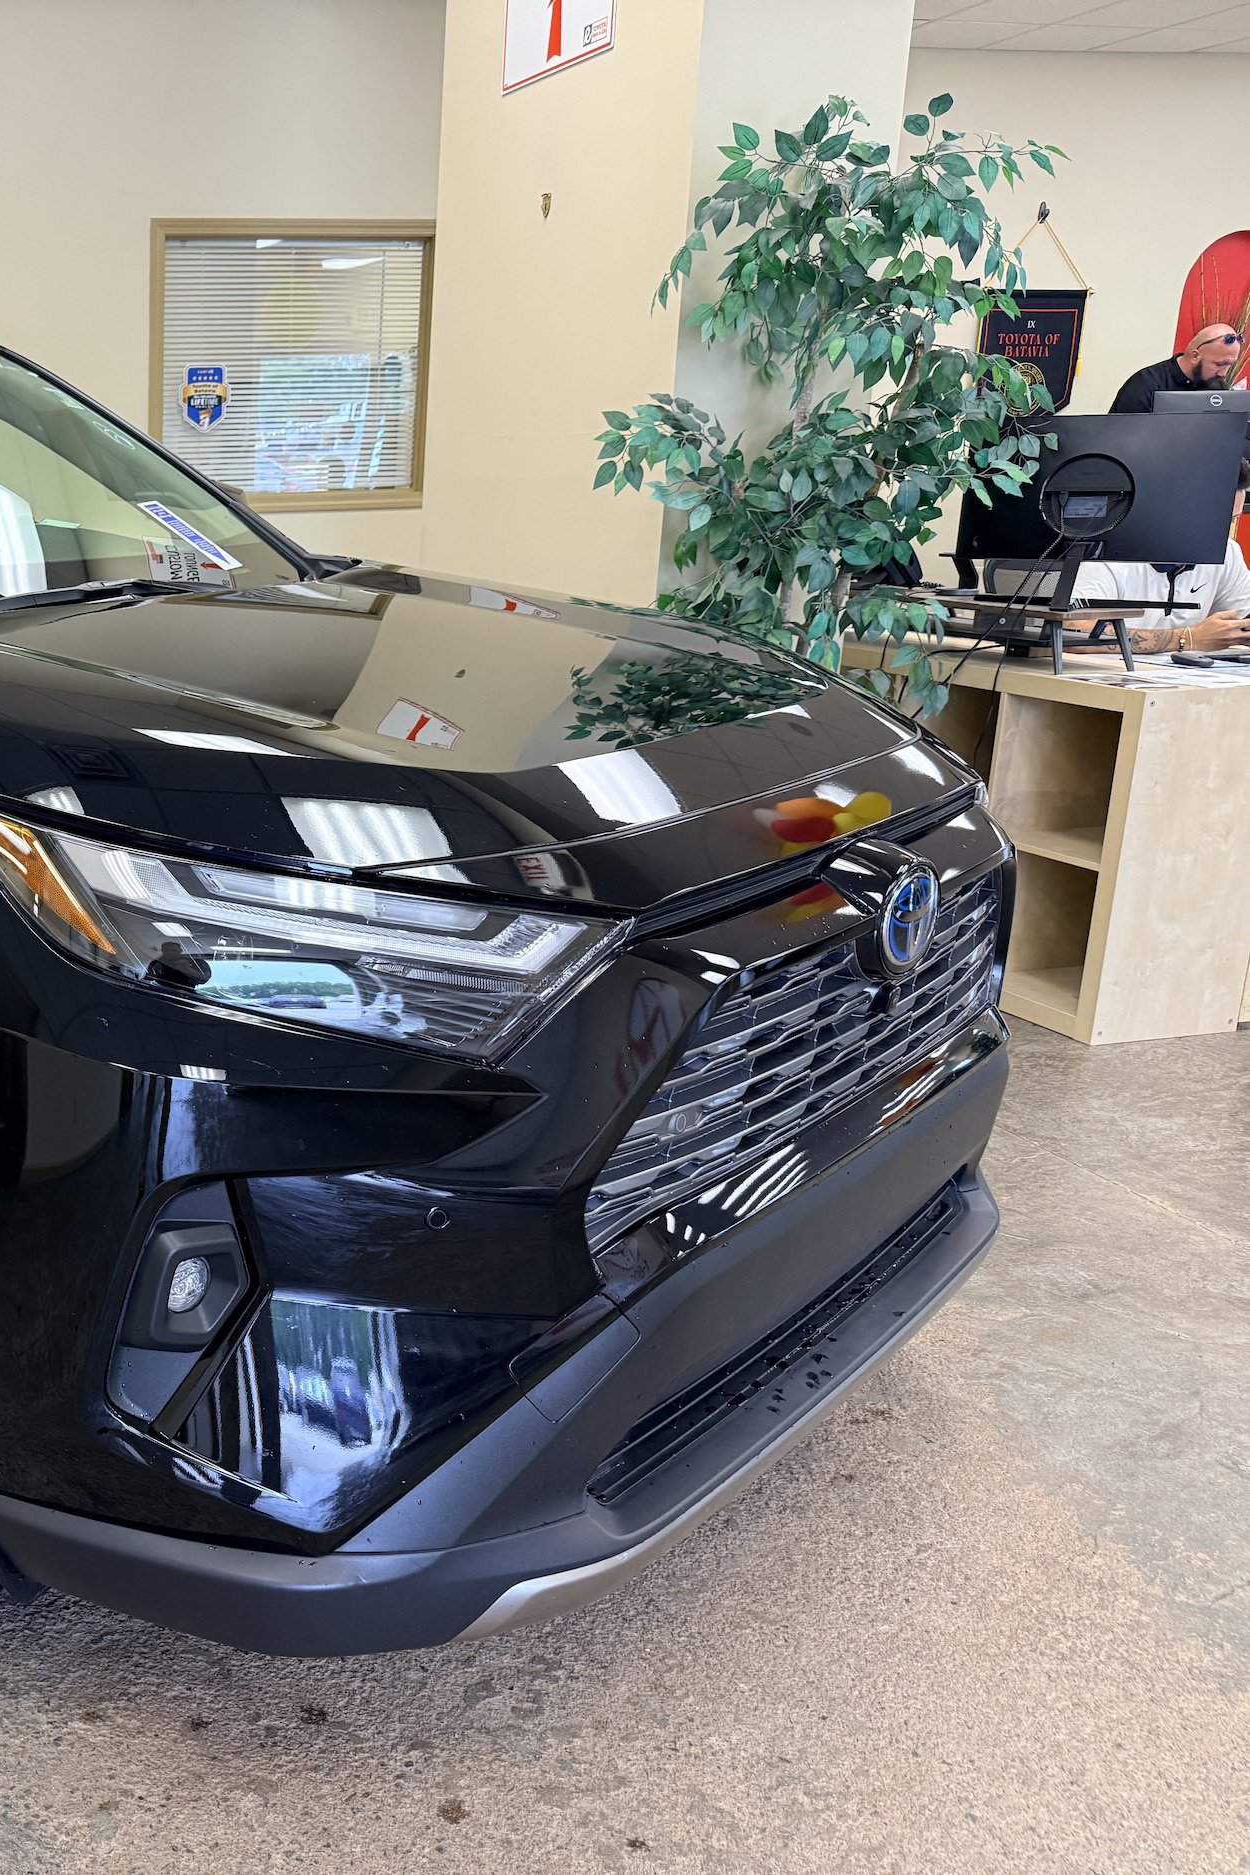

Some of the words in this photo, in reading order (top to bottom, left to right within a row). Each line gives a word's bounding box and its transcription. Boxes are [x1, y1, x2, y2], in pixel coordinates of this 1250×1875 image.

[998, 333, 1041, 345] TOYOTA
[1045, 333, 1060, 345] OF
[1005, 346, 1049, 357] BATAVIA
